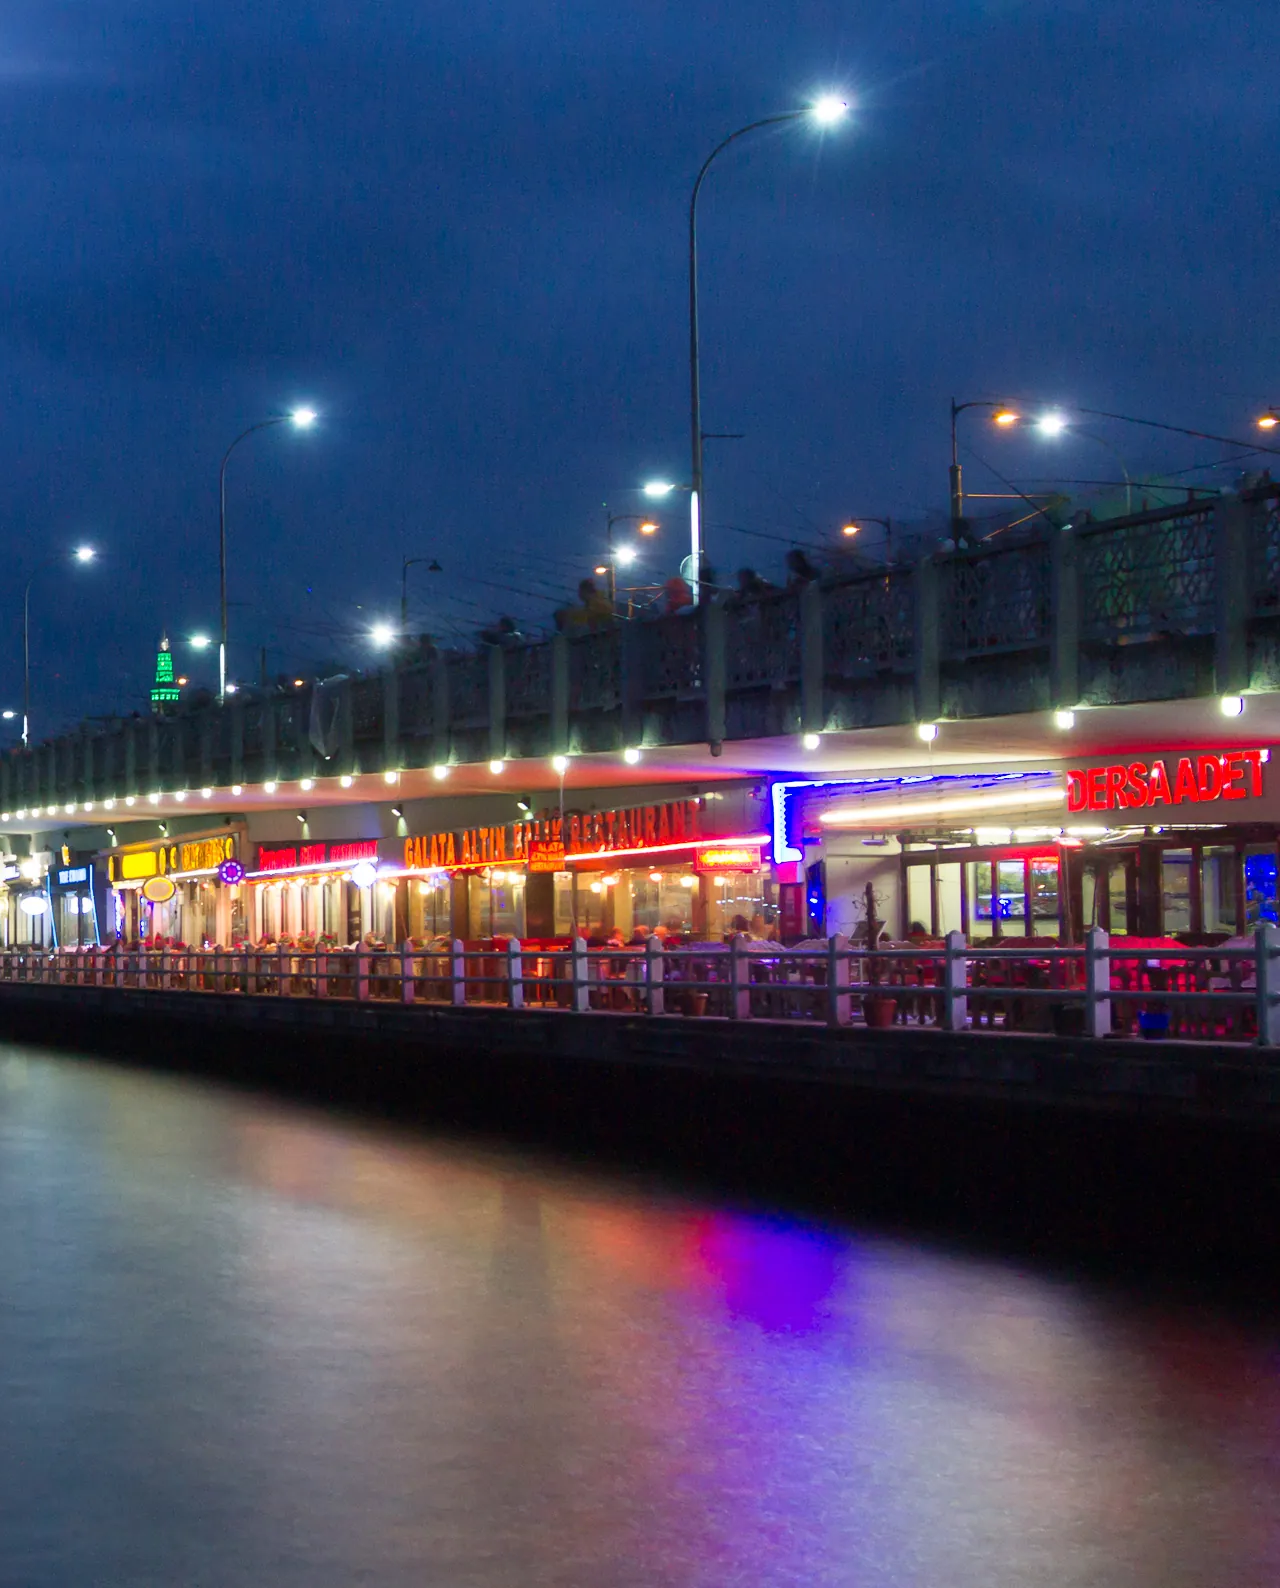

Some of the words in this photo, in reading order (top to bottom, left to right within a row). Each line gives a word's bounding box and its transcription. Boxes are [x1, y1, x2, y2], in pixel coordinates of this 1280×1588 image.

[1066, 749, 1266, 812] DERSAADET
[404, 832, 456, 867] GALATA
[462, 825, 506, 864] ALTIN
[570, 799, 702, 853] RESTAURANT
